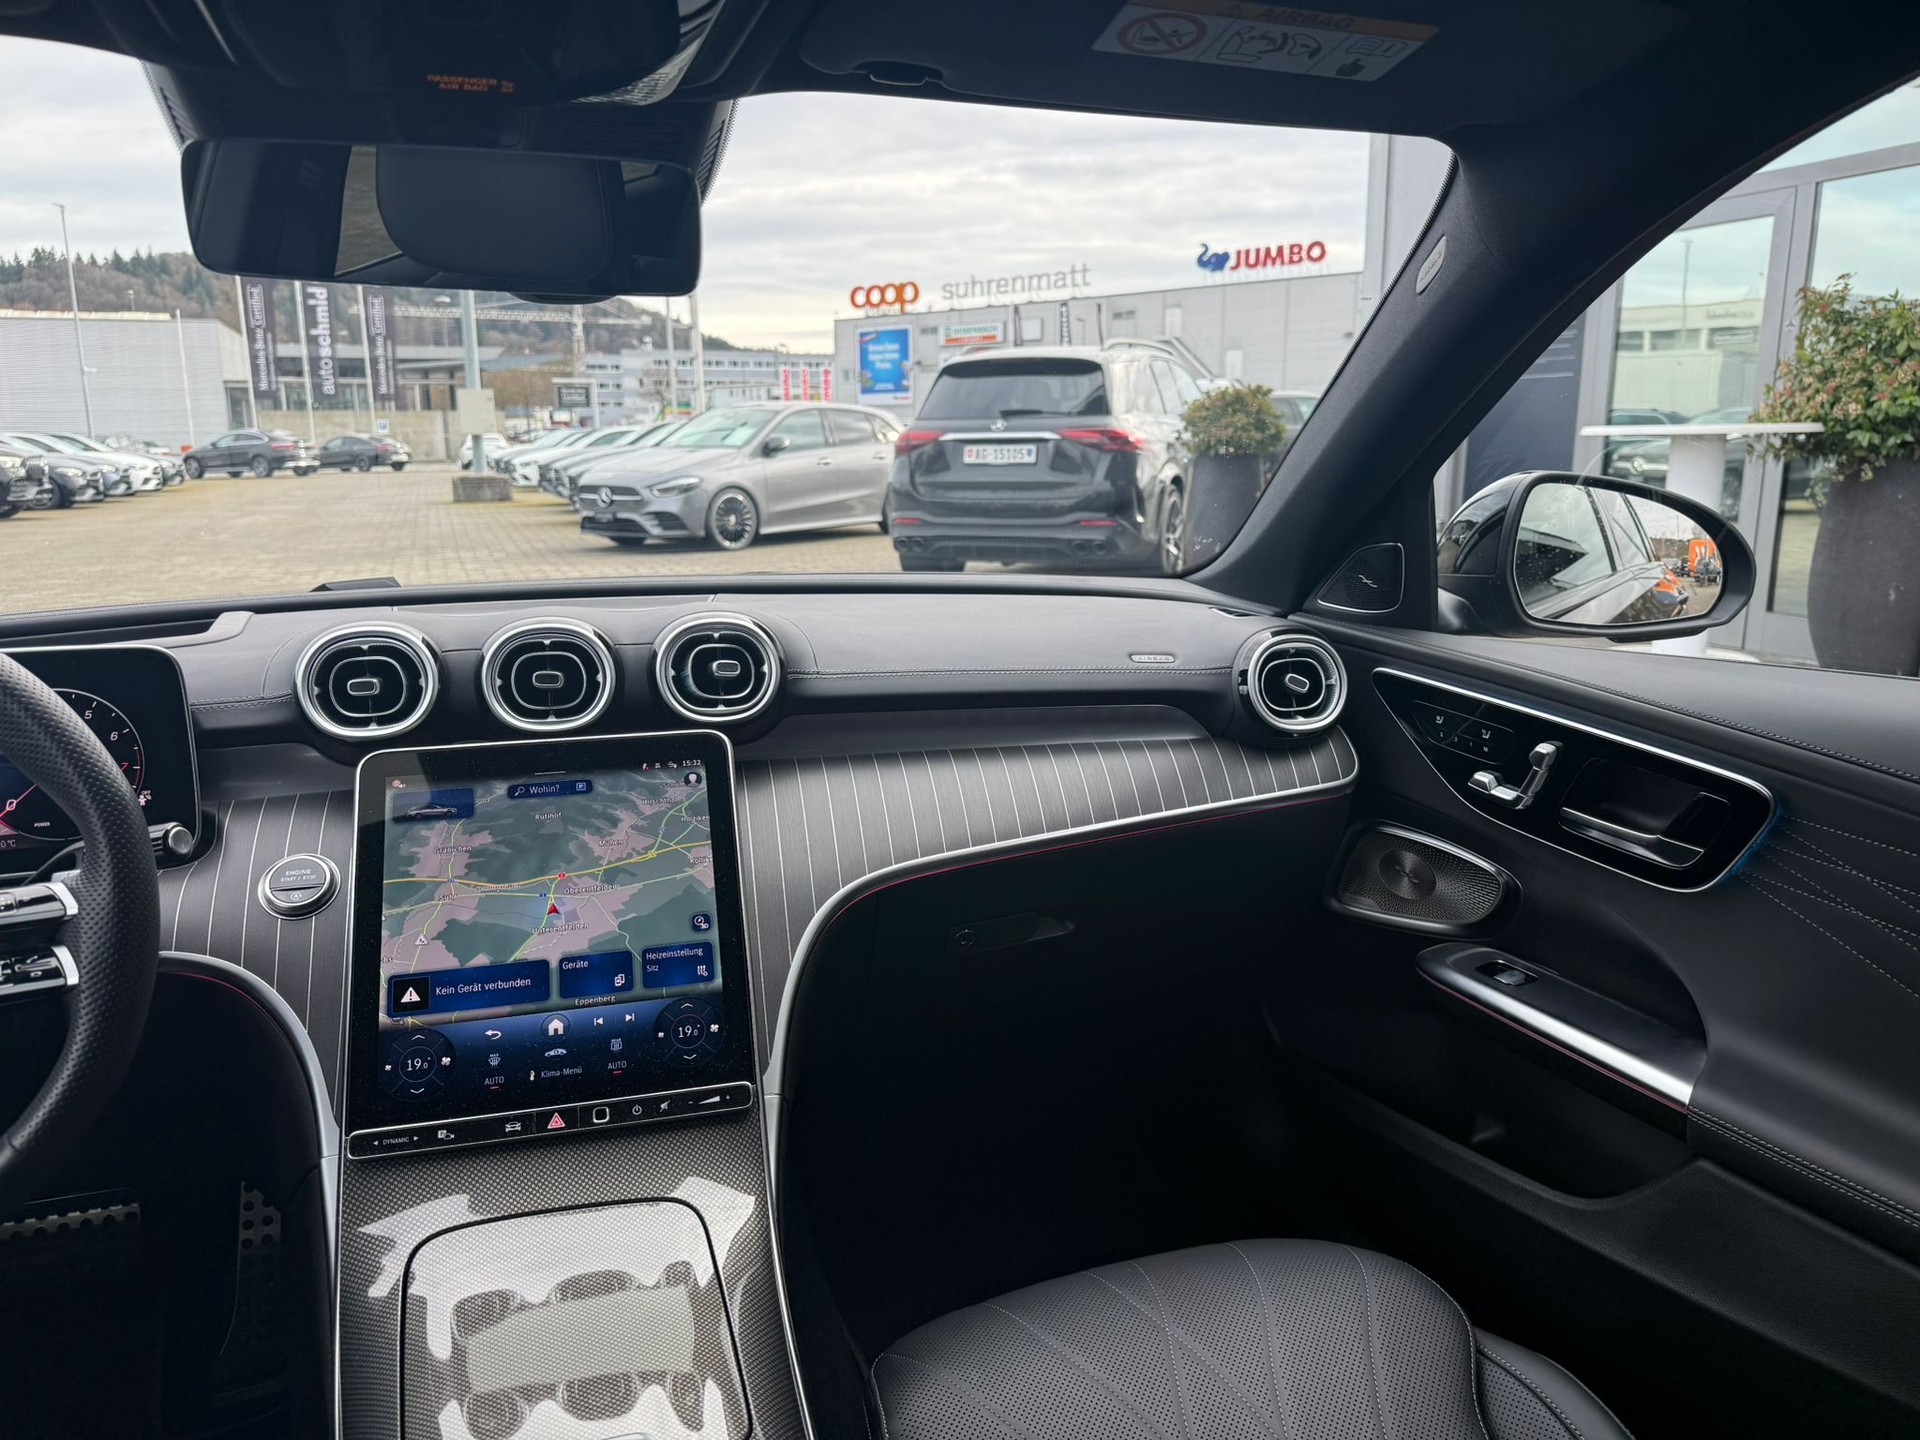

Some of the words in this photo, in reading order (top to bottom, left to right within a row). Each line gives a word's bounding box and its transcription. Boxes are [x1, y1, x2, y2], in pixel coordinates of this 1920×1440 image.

[1251, 6, 1355, 29] AIRBAG
[427, 74, 497, 86] PASSENGER
[1230, 241, 1326, 270] JUMBO
[941, 263, 1091, 301] suhrenmatt
[850, 280, 920, 314] coop
[306, 286, 336, 396] autoschmid
[84, 710, 93, 719] 5
[110, 731, 119, 741] 6
[682, 759, 701, 767] 15:32
[529, 784, 560, 794] Wohin?
[285, 868, 311, 876] ENGINE
[439, 893, 456, 901] Suhr
[646, 947, 704, 960] Heizeinstellung
[562, 959, 589, 970] Geräte
[646, 964, 659, 972] Sitz
[436, 984, 455, 996] Kein
[457, 982, 482, 994] Gerät
[484, 977, 531, 991] verbunden
[575, 995, 616, 1006] Eppenberg
[607, 1061, 627, 1070] AUTO
[541, 1065, 583, 1079] Klima-Menü
[484, 1076, 505, 1086] AUTO
[382, 1136, 410, 1146] DYNAMIC
